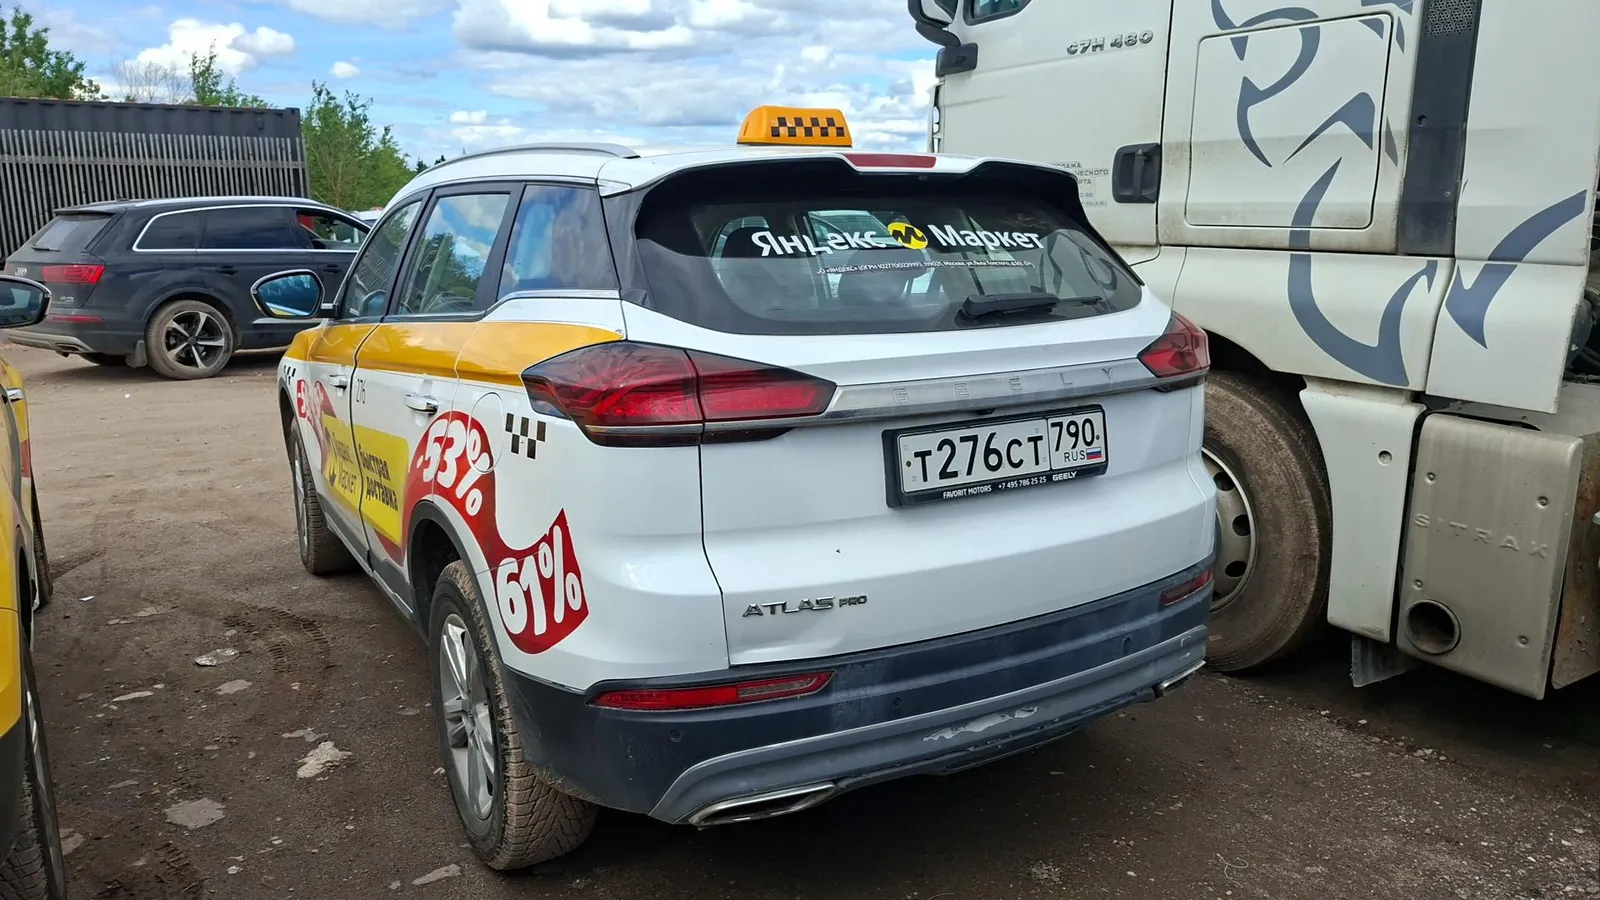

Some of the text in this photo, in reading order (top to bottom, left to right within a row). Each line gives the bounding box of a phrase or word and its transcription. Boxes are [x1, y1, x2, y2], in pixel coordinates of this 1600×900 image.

[751, 224, 1045, 257] Яндекс Маркет
[891, 366, 1113, 404] GEELY
[416, 418, 490, 517] -53%
[913, 417, 1096, 483] Т276СТ 790
[1063, 449, 1086, 463] RUS
[942, 488, 968, 499] FAVORIT
[968, 484, 992, 495] MOTORS
[1006, 480, 1018, 489] 495
[1030, 476, 1039, 485] 25
[1039, 475, 1047, 484] 25
[1052, 471, 1077, 481] GEELY
[496, 524, 582, 636] 61%
[741, 594, 868, 618] ATLAS PRO
